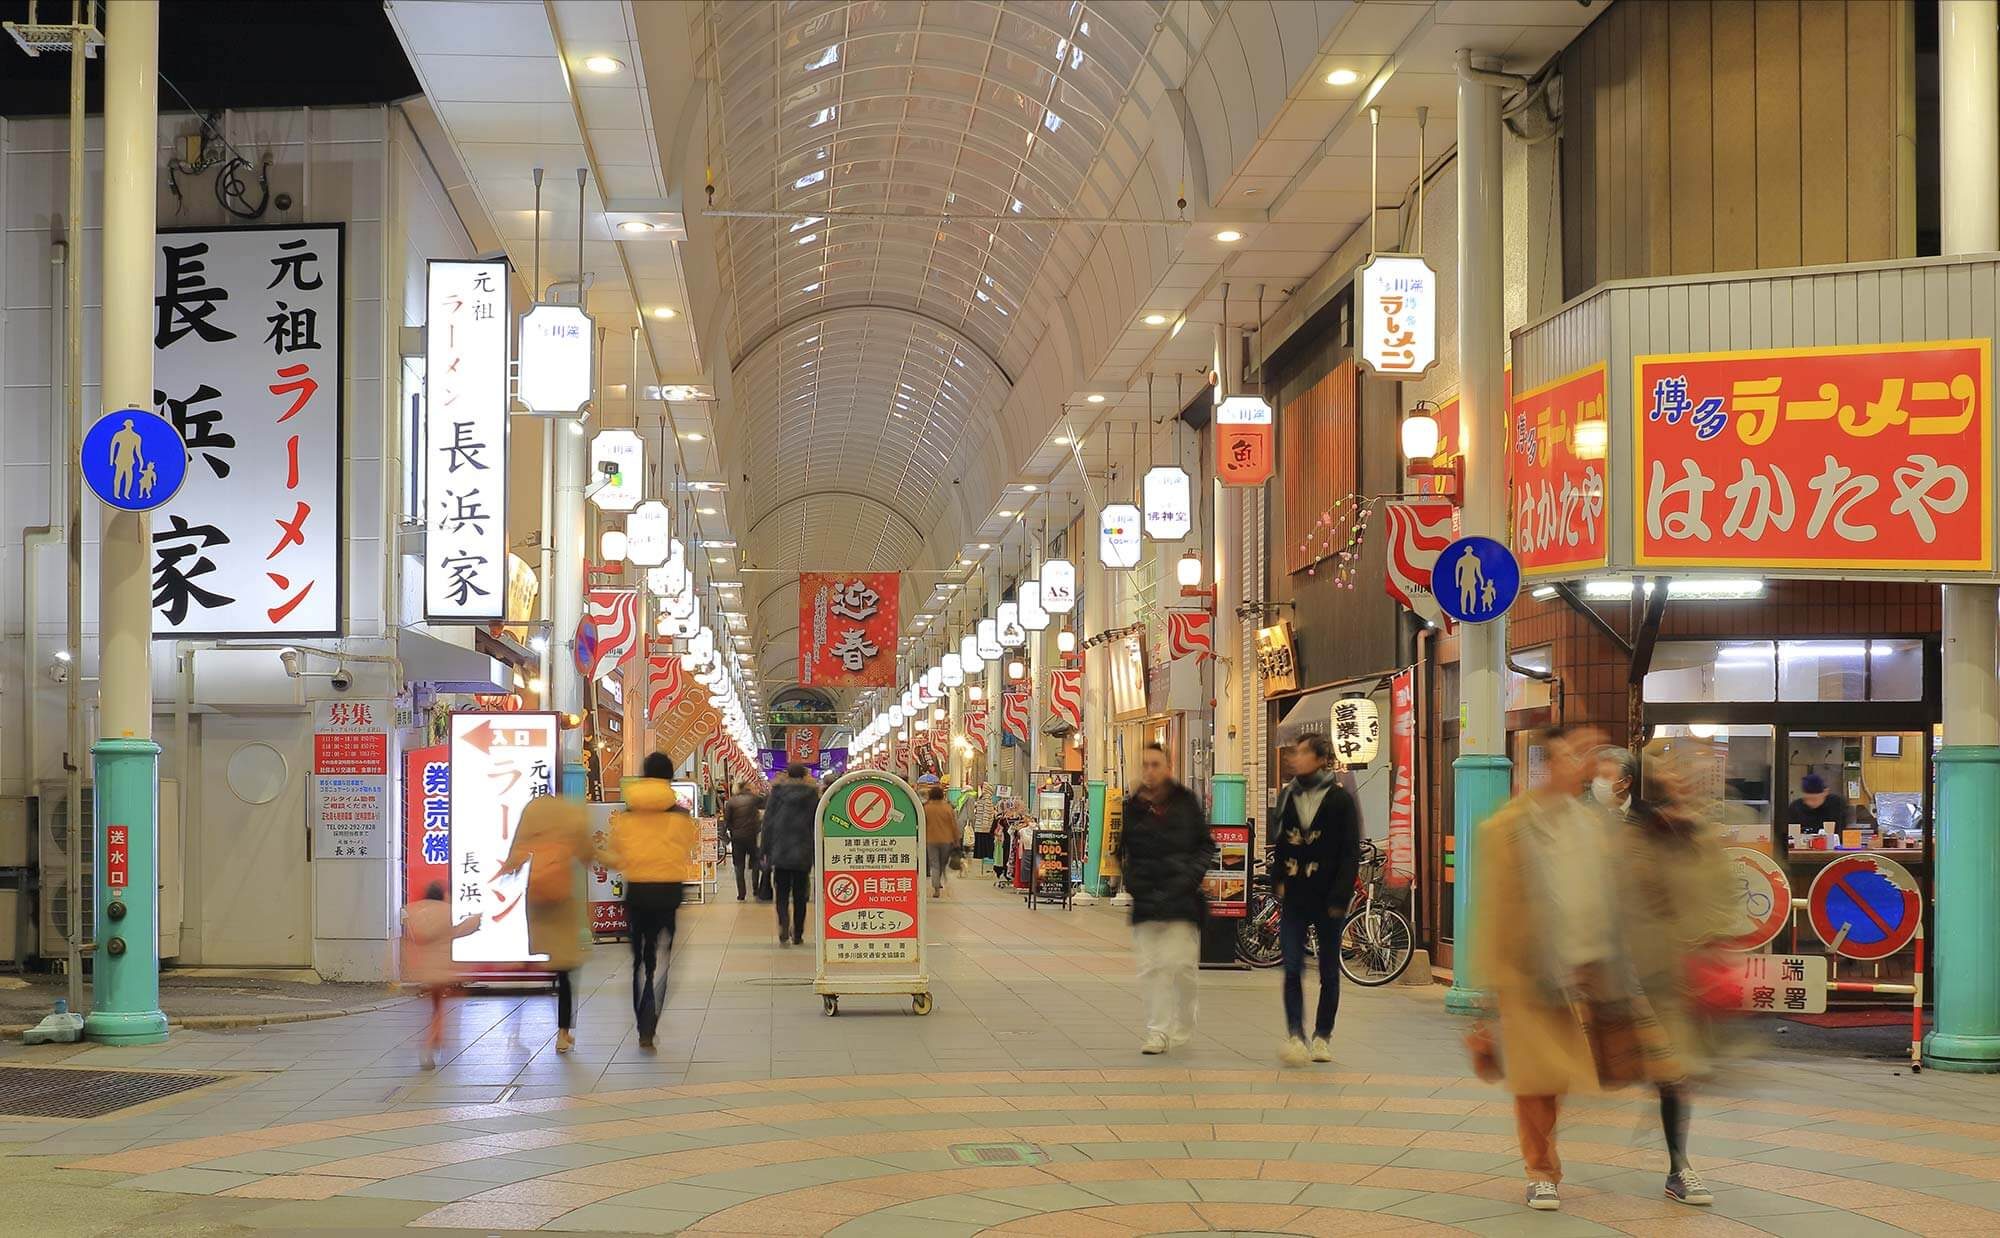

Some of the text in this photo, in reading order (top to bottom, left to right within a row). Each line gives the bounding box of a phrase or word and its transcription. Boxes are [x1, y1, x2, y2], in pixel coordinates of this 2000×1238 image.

[472, 272, 496, 321] 元祖
[442, 294, 463, 406] ラーメン
[438, 421, 491, 606] 長浜家
[1517, 466, 1604, 553] はかたや
[1646, 454, 1969, 545] はかたや
[830, 579, 880, 671] 迎春
[329, 703, 373, 725] 募集
[492, 729, 530, 746] 入口
[1335, 703, 1361, 757] 営業中
[109, 830, 125, 884] 送水口
[831, 853, 910, 864] 歩行者専用道路
[863, 877, 913, 893] 自転車
[858, 911, 885, 920] 押して
[1745, 957, 1804, 982] 川端
